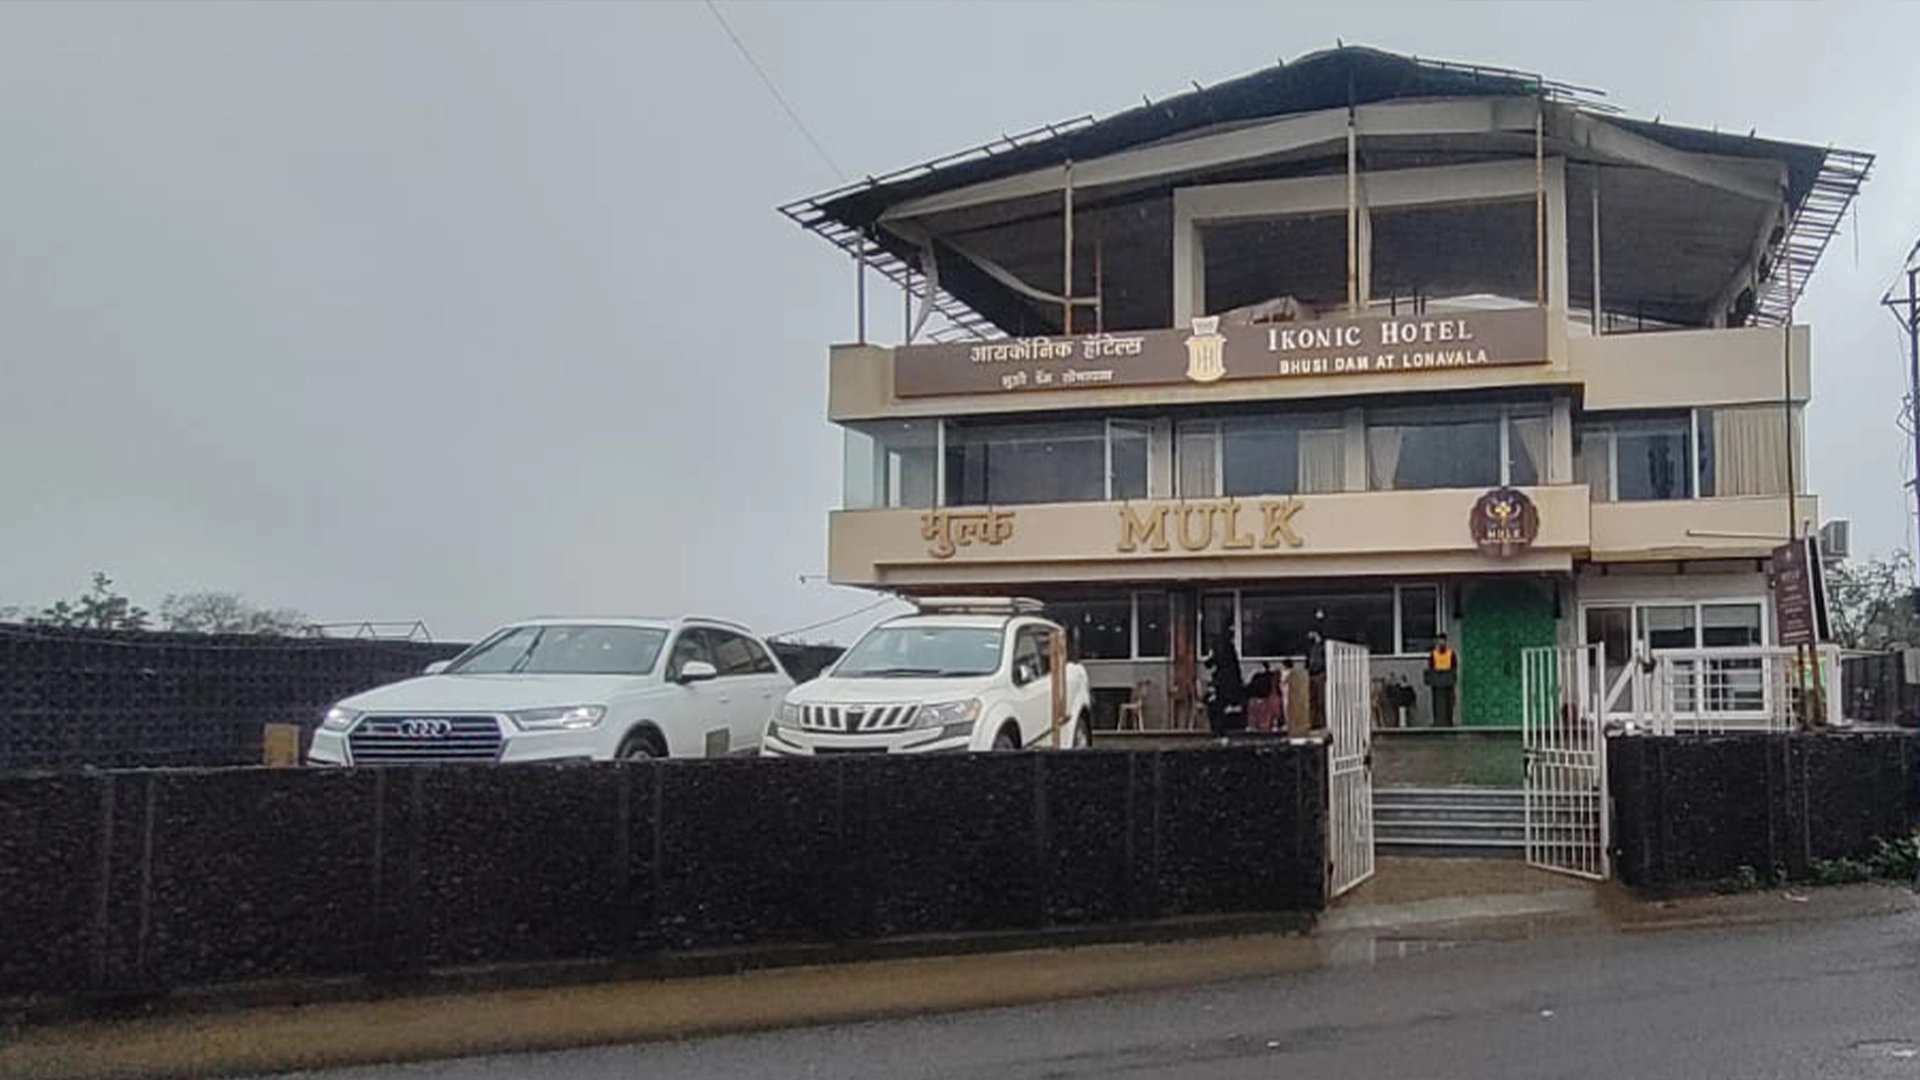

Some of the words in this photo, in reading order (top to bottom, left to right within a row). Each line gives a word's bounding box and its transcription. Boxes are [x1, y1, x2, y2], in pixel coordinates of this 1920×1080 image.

[969, 337, 1075, 363] आयकॉनिक
[1267, 327, 1360, 351] IKONIC
[1380, 320, 1473, 344] HOTEL
[1280, 358, 1328, 374] BHUSI
[1334, 355, 1369, 371] DAM
[1376, 354, 1397, 370] AT
[1402, 349, 1488, 369] LONAVALA
[921, 511, 1016, 559] मुल्क
[1119, 500, 1304, 553] MULK
